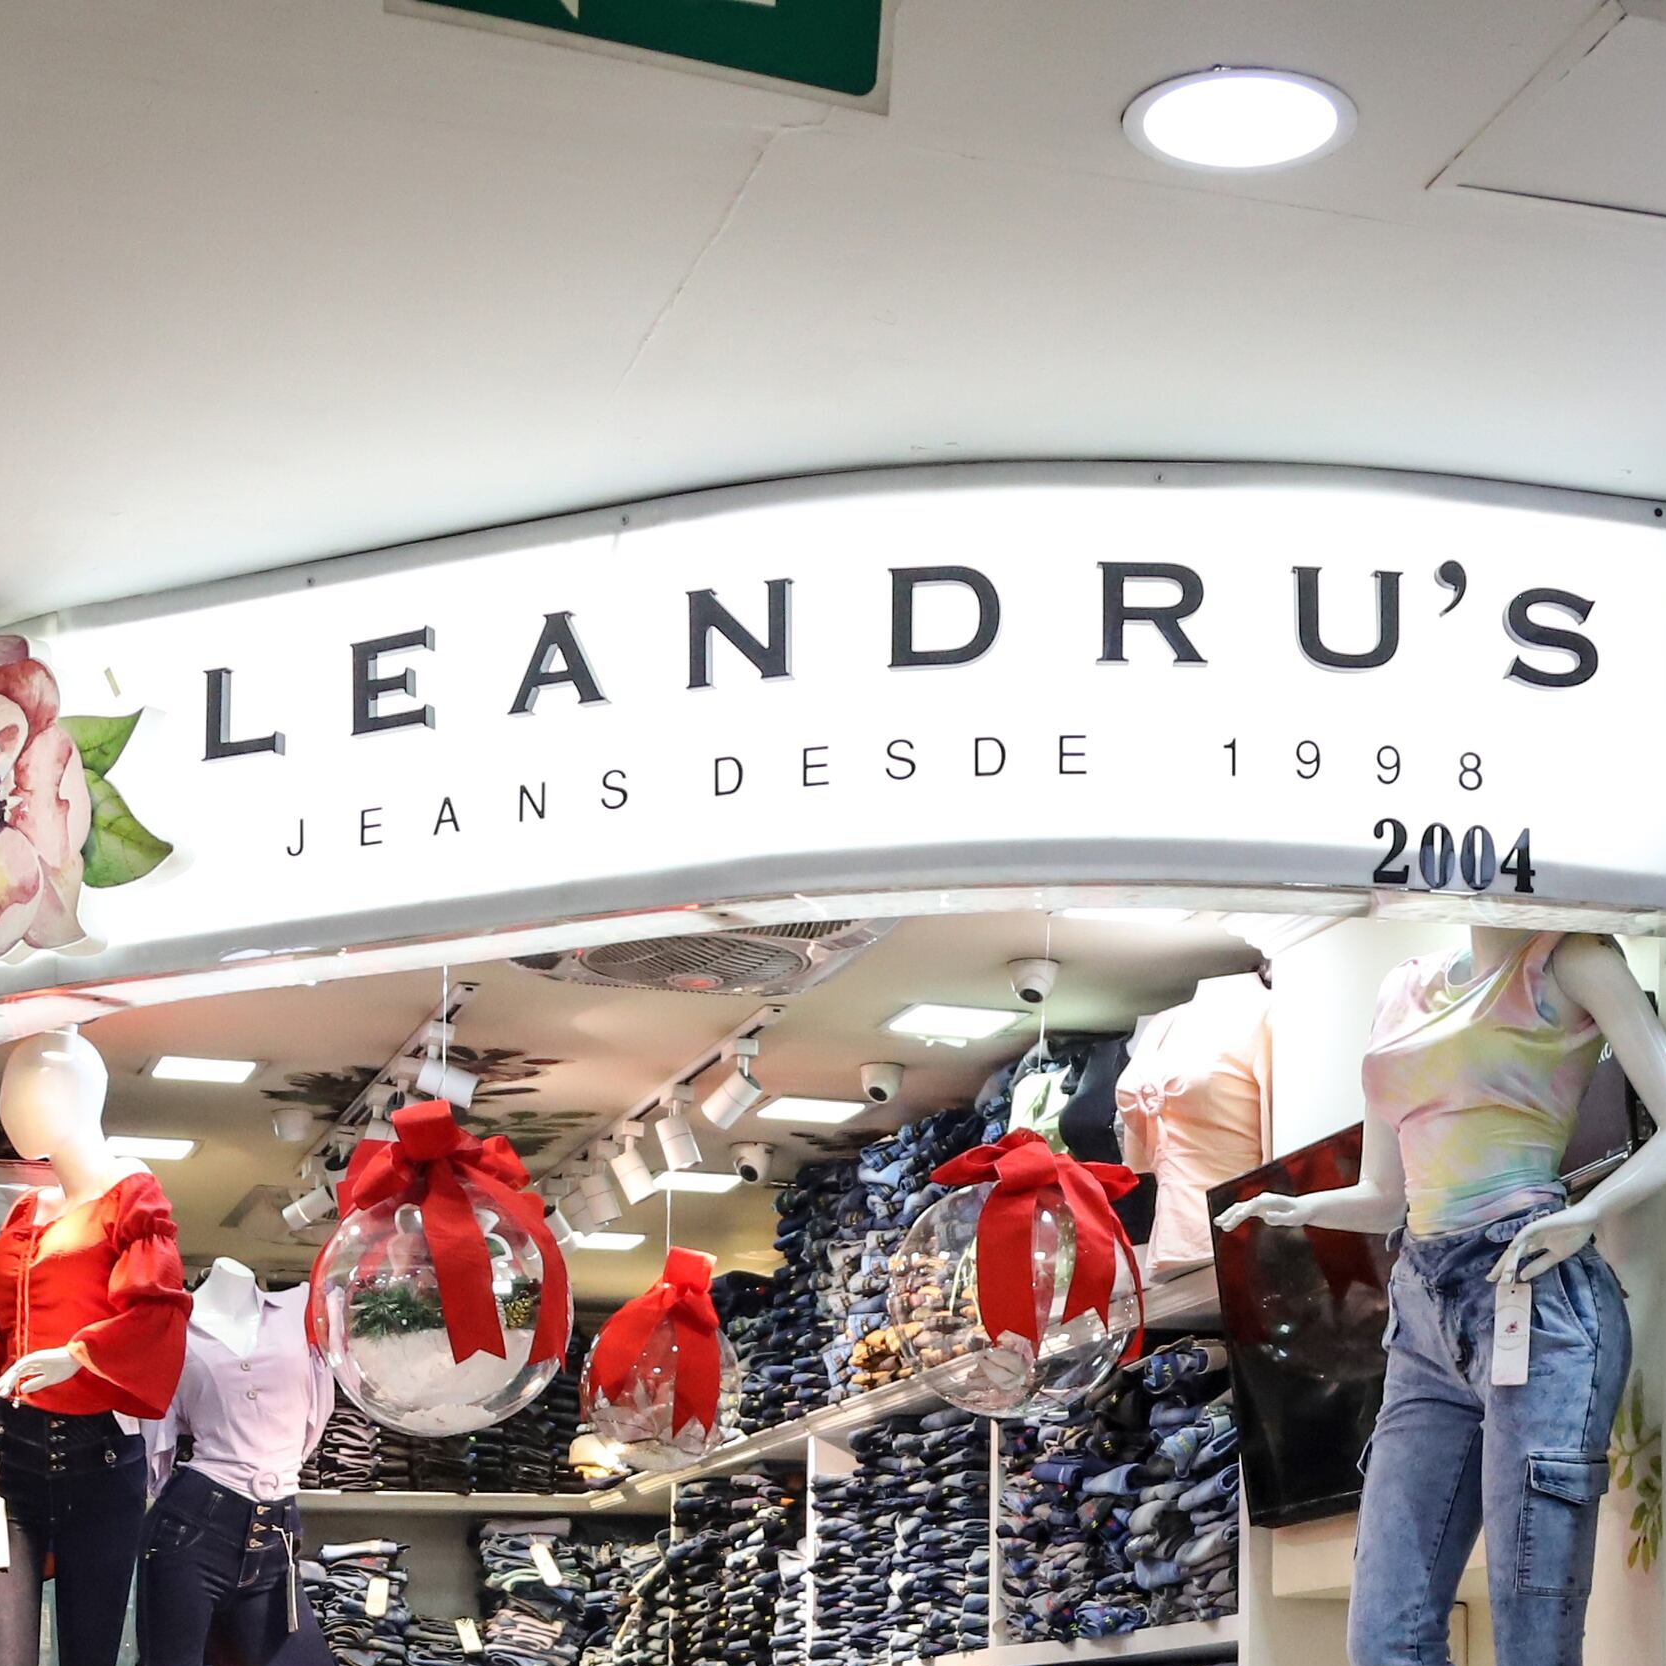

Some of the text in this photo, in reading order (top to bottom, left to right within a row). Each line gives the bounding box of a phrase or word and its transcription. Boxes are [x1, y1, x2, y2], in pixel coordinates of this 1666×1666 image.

[201, 560, 1601, 763] LEANDRU'S
[285, 734, 1485, 859] JEANS DESDE 1998
[1371, 817, 1537, 894] 2004
